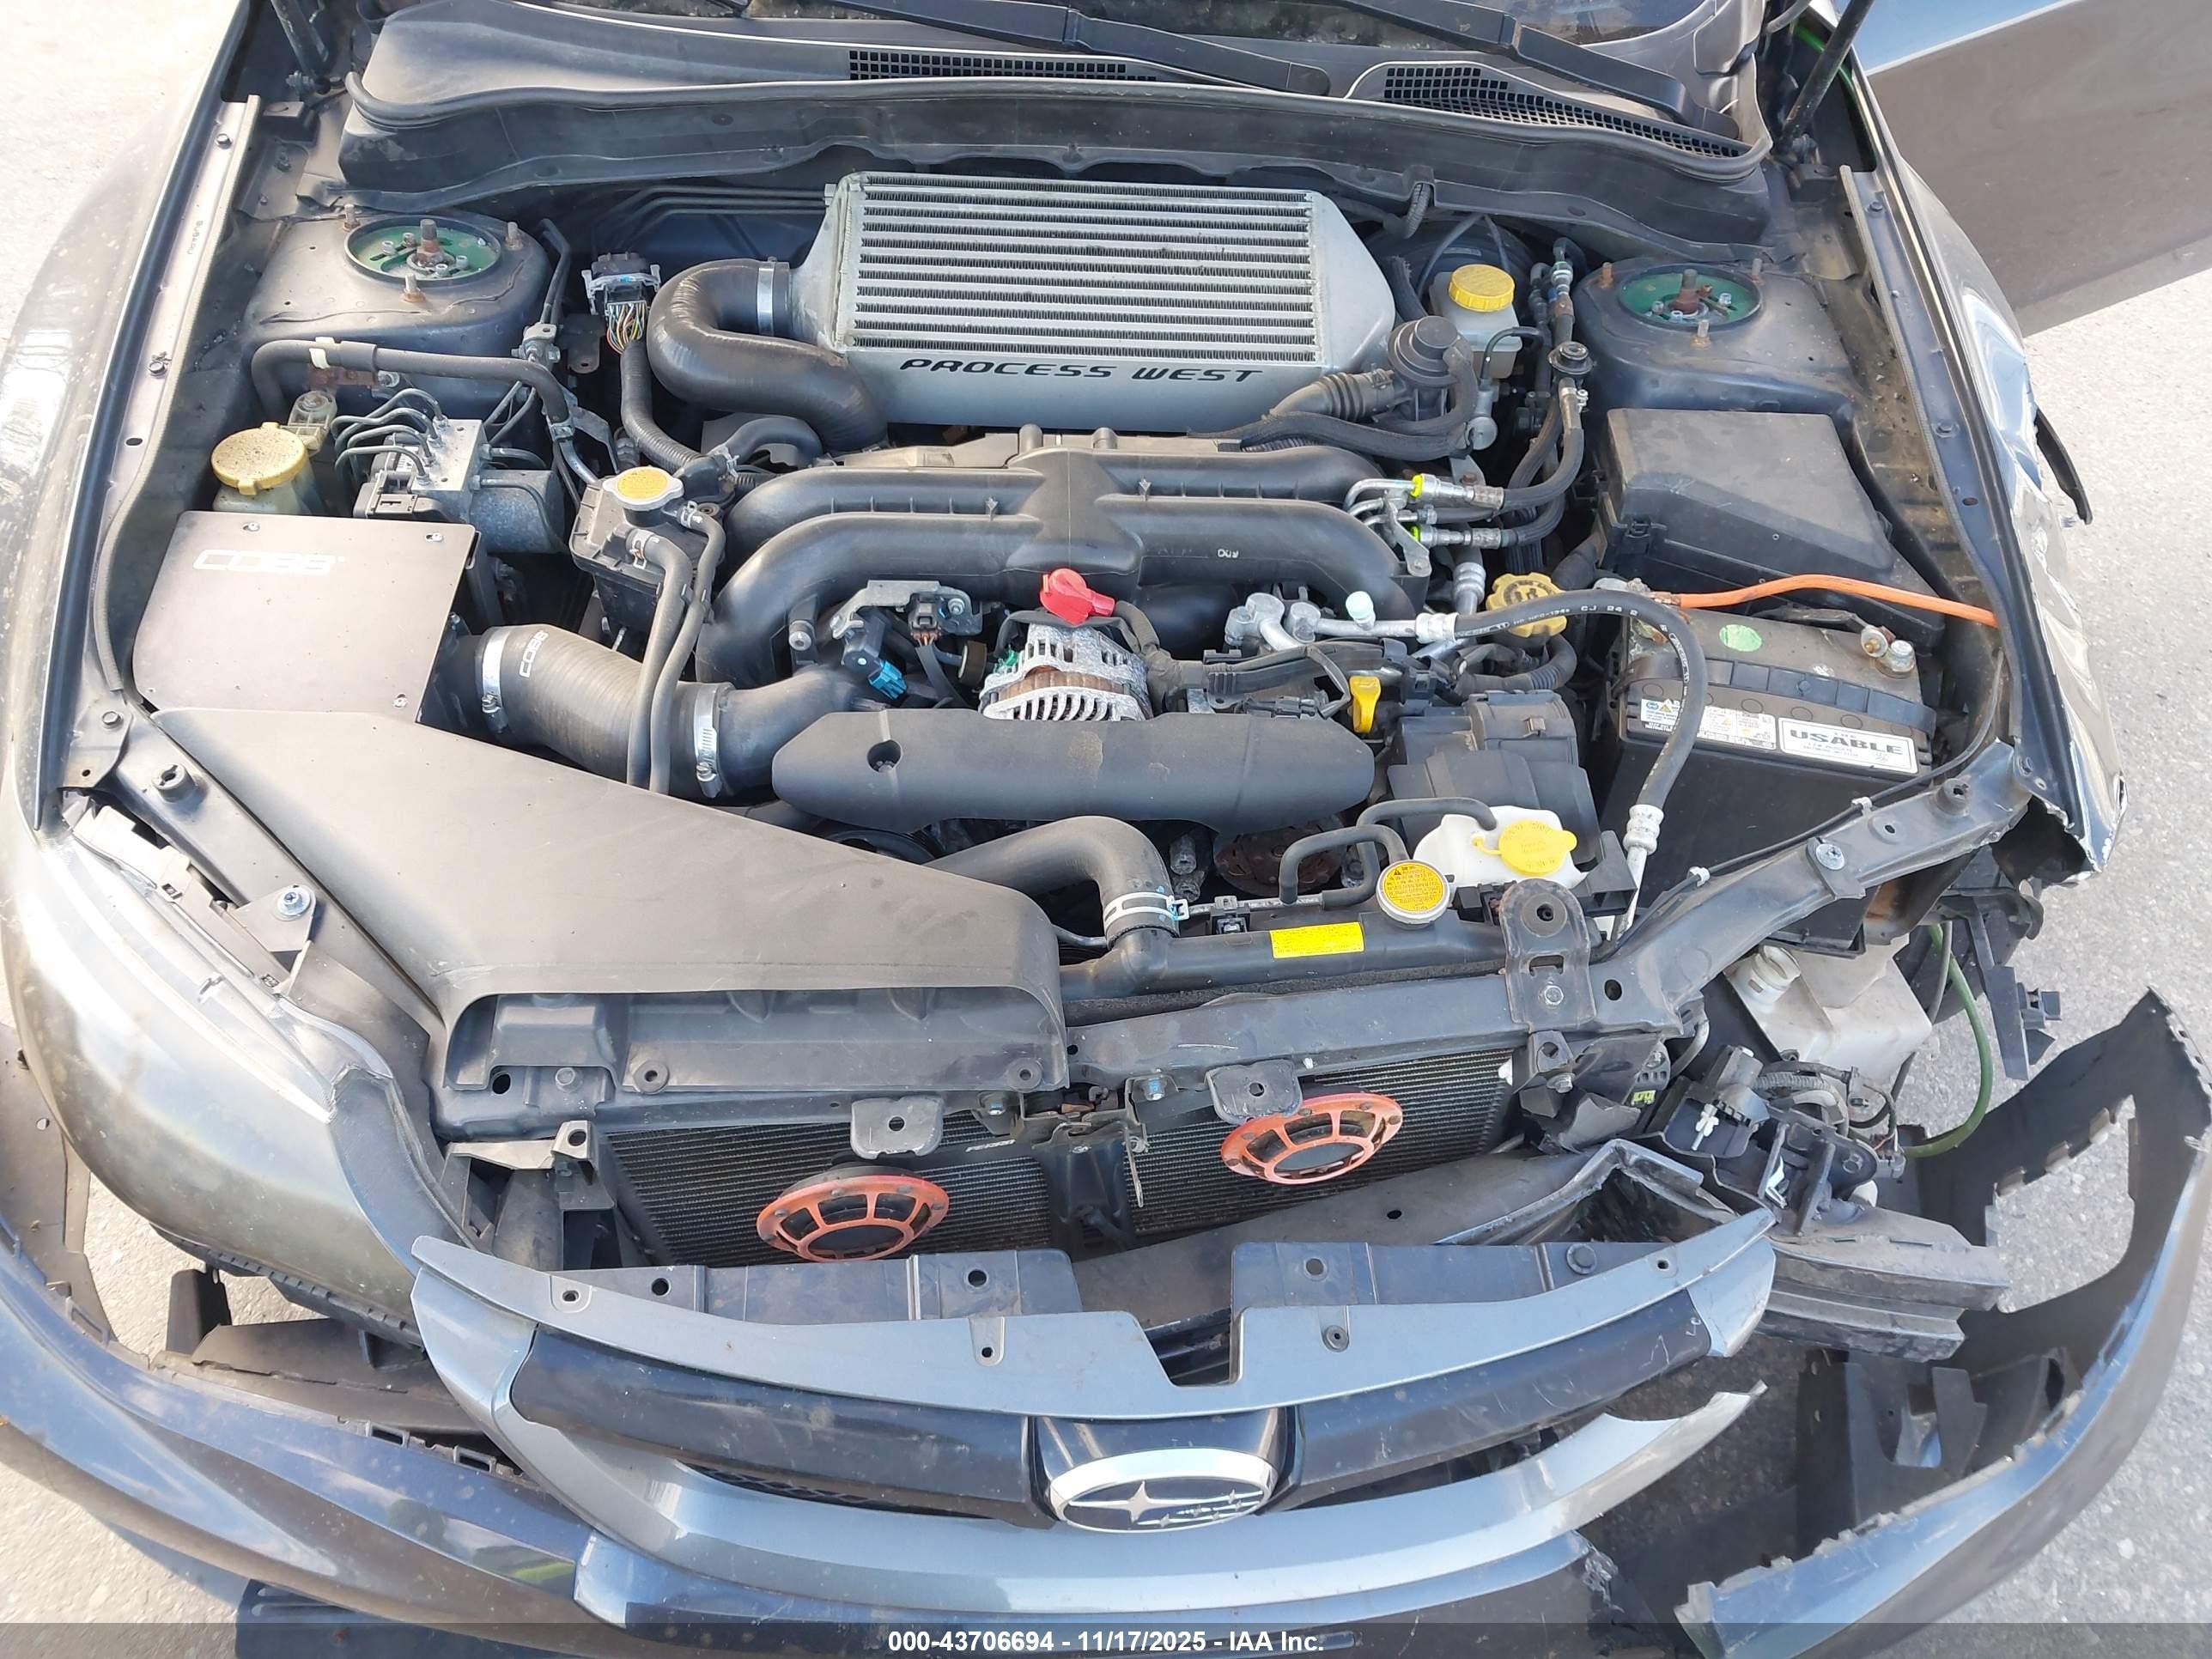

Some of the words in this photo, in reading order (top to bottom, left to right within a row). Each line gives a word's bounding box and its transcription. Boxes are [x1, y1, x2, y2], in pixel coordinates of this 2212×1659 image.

[899, 358, 1118, 379] PROCESS
[1131, 367, 1264, 382] WEST
[192, 549, 337, 577] COBB
[519, 630, 550, 678] COBB
[1790, 729, 1904, 756] USABLE
